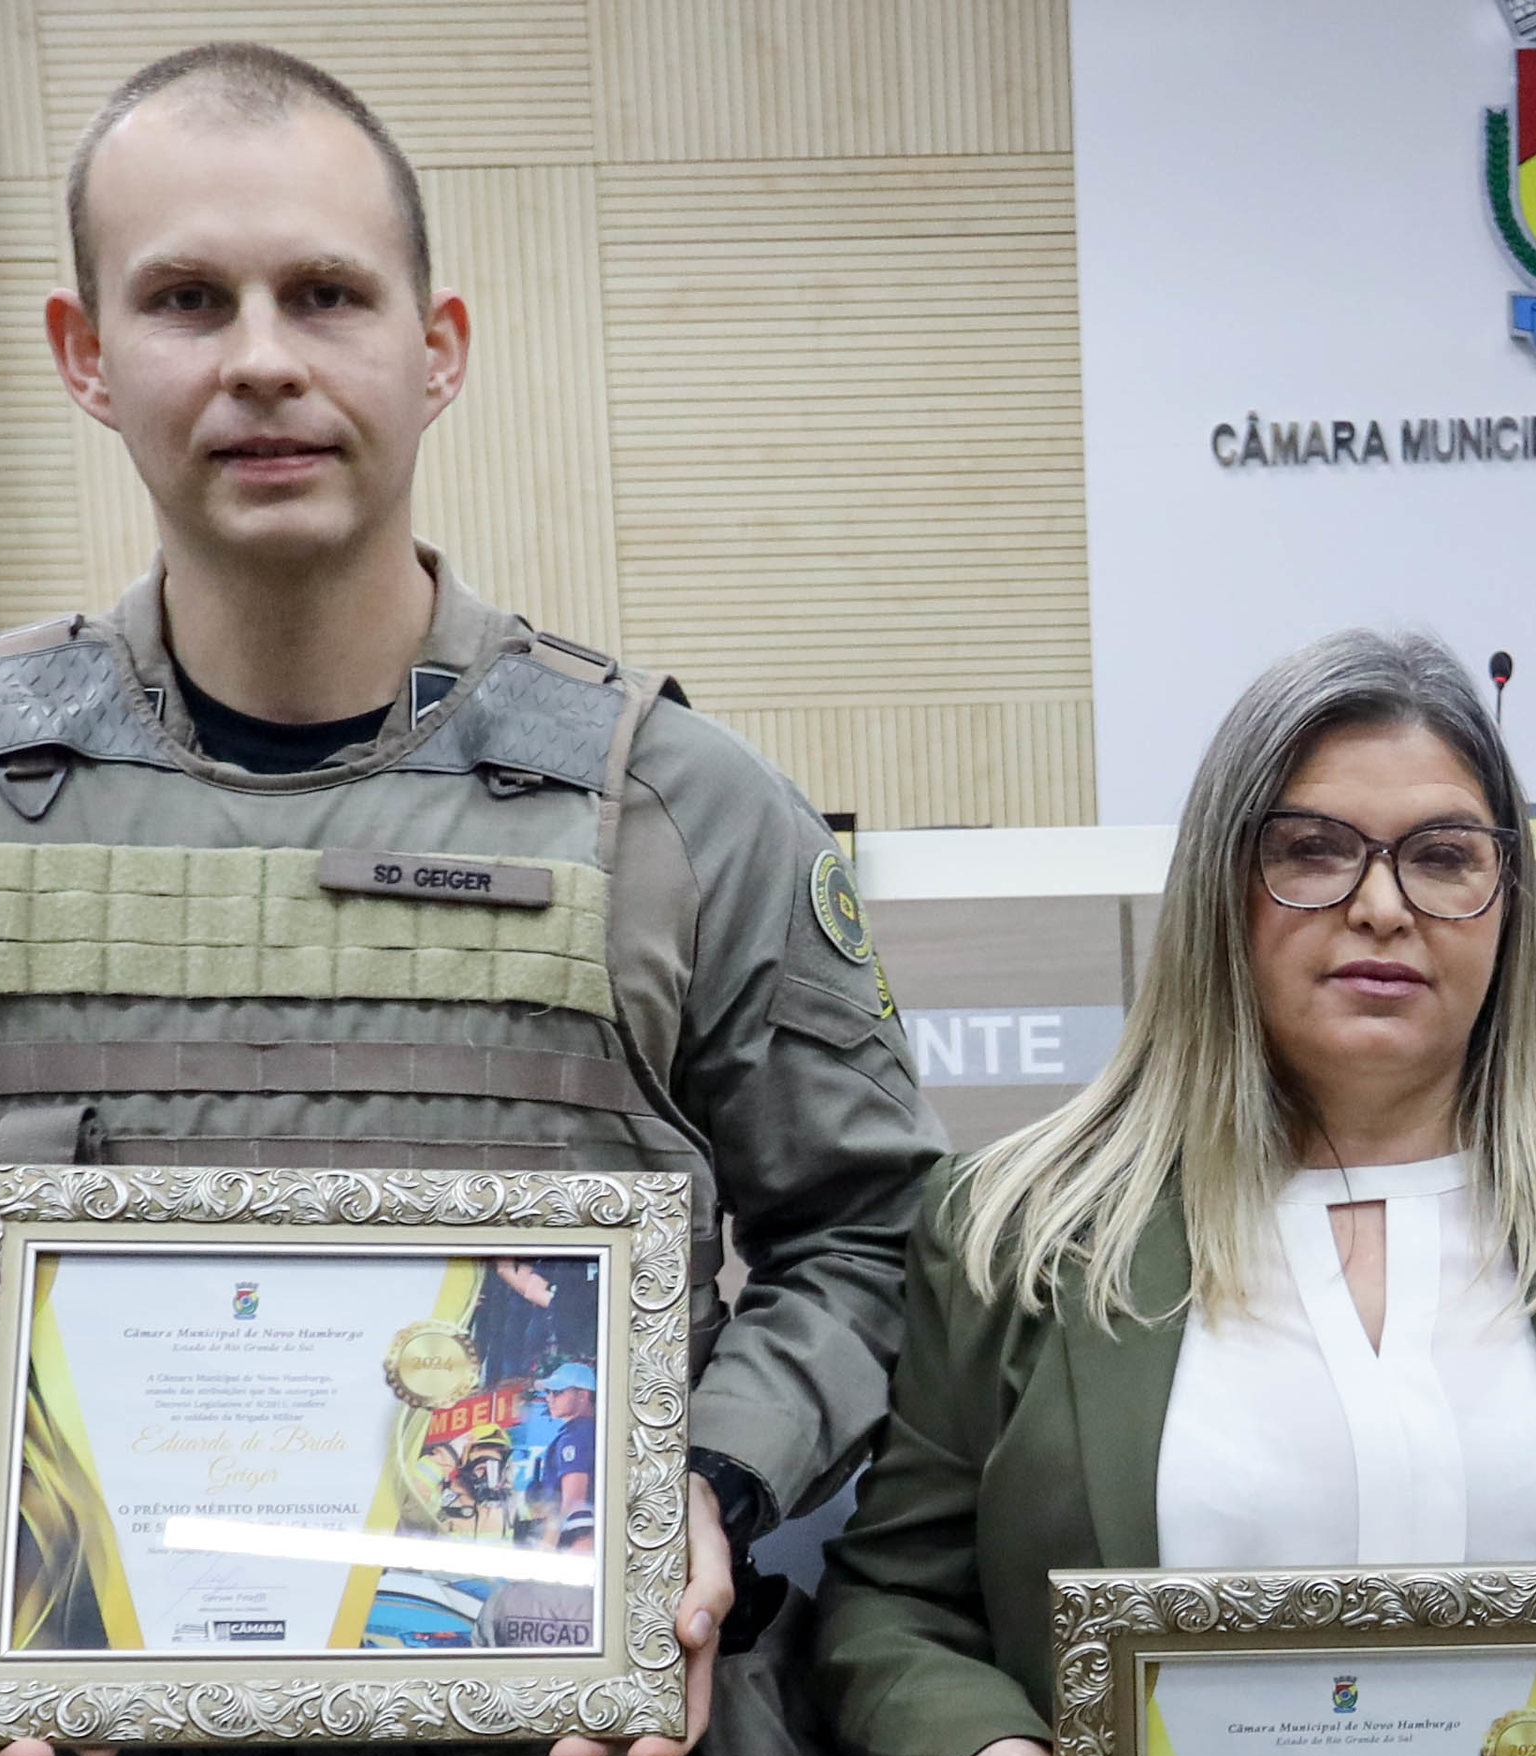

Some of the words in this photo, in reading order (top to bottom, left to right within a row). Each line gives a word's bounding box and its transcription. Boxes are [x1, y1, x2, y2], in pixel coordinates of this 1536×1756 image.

[1212, 409, 1388, 467] CÂMARA
[374, 865, 402, 884] SD
[414, 869, 491, 892] GEIGER
[906, 1015, 1064, 1076] NTE
[118, 1506, 129, 1515] O
[134, 1502, 190, 1515] PRÊMIO
[195, 1502, 252, 1514] MÉRITO
[257, 1504, 360, 1514] PROFISSIONAL
[230, 1621, 284, 1634] CÂMARA
[1228, 1724, 1275, 1733] Câmara
[1279, 1722, 1341, 1733] Municipal
[1345, 1722, 1358, 1731] de
[1363, 1722, 1393, 1731] Novo
[1397, 1720, 1460, 1731] Hamburgo
